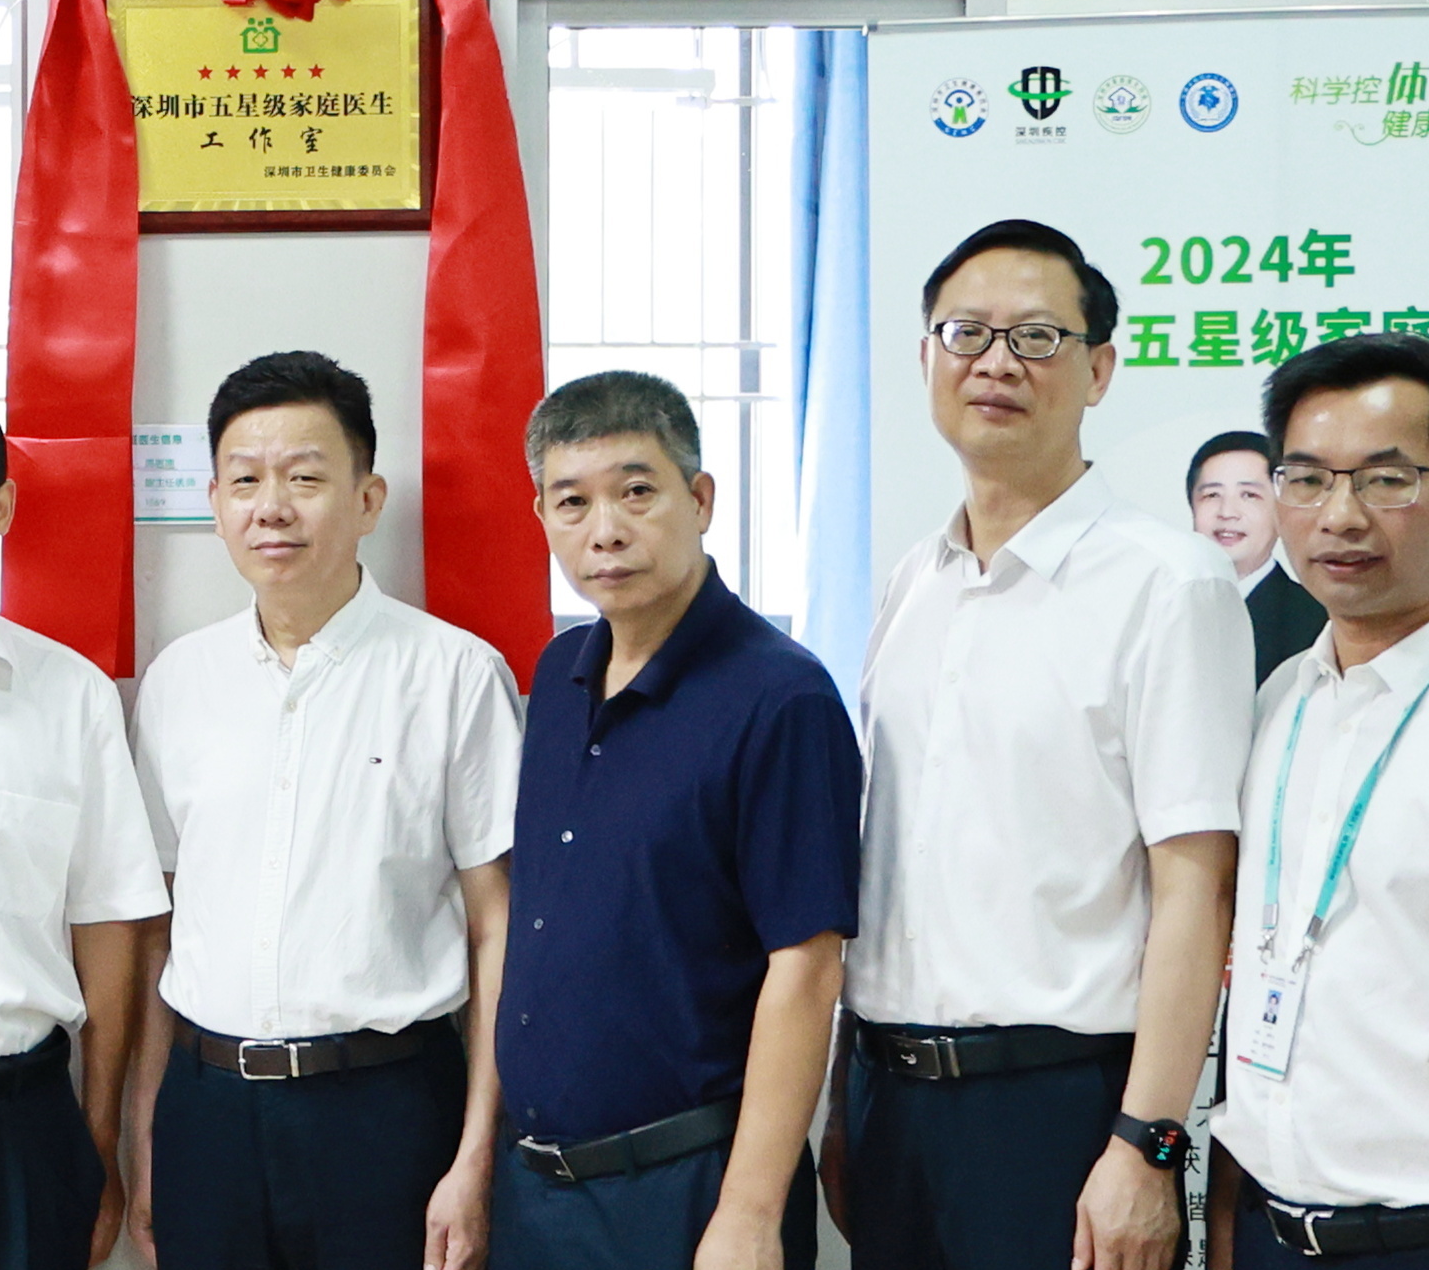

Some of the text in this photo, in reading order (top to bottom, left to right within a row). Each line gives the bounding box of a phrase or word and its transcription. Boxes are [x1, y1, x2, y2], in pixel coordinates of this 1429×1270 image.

[131, 91, 393, 119] 深圳市五星级家庭医生
[200, 126, 324, 154] 工作室
[263, 164, 396, 178] 深圳市卫生健康委员会
[1140, 228, 1355, 288] 2024年
